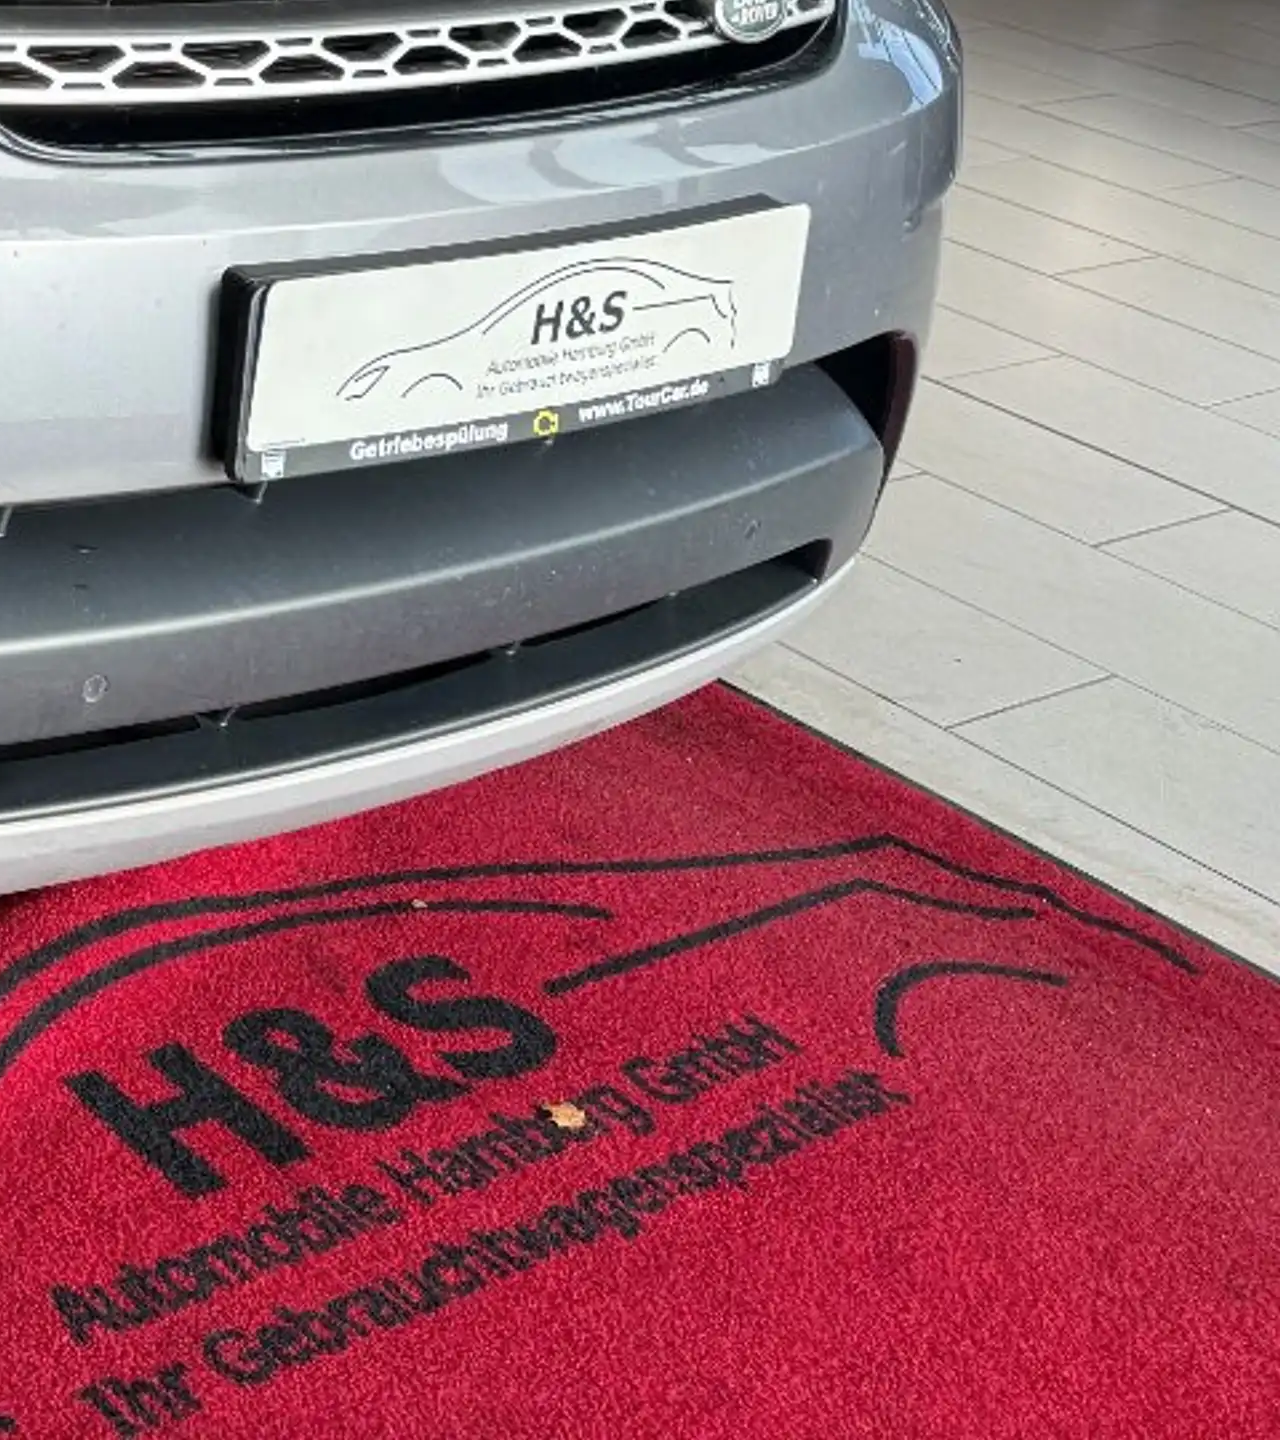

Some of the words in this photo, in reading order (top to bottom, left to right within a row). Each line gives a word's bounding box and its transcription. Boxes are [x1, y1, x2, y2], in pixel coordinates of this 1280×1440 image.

[349, 420, 510, 462] Getriebespülung
[578, 377, 710, 424] www.TourCar.de
[531, 291, 627, 345] H&S
[51, 1183, 403, 1347] Automobile
[622, 1013, 801, 1103] GmbH
[62, 955, 557, 1200] H&S
[201, 1071, 911, 1386] Gebrauchtwagenspezialist
